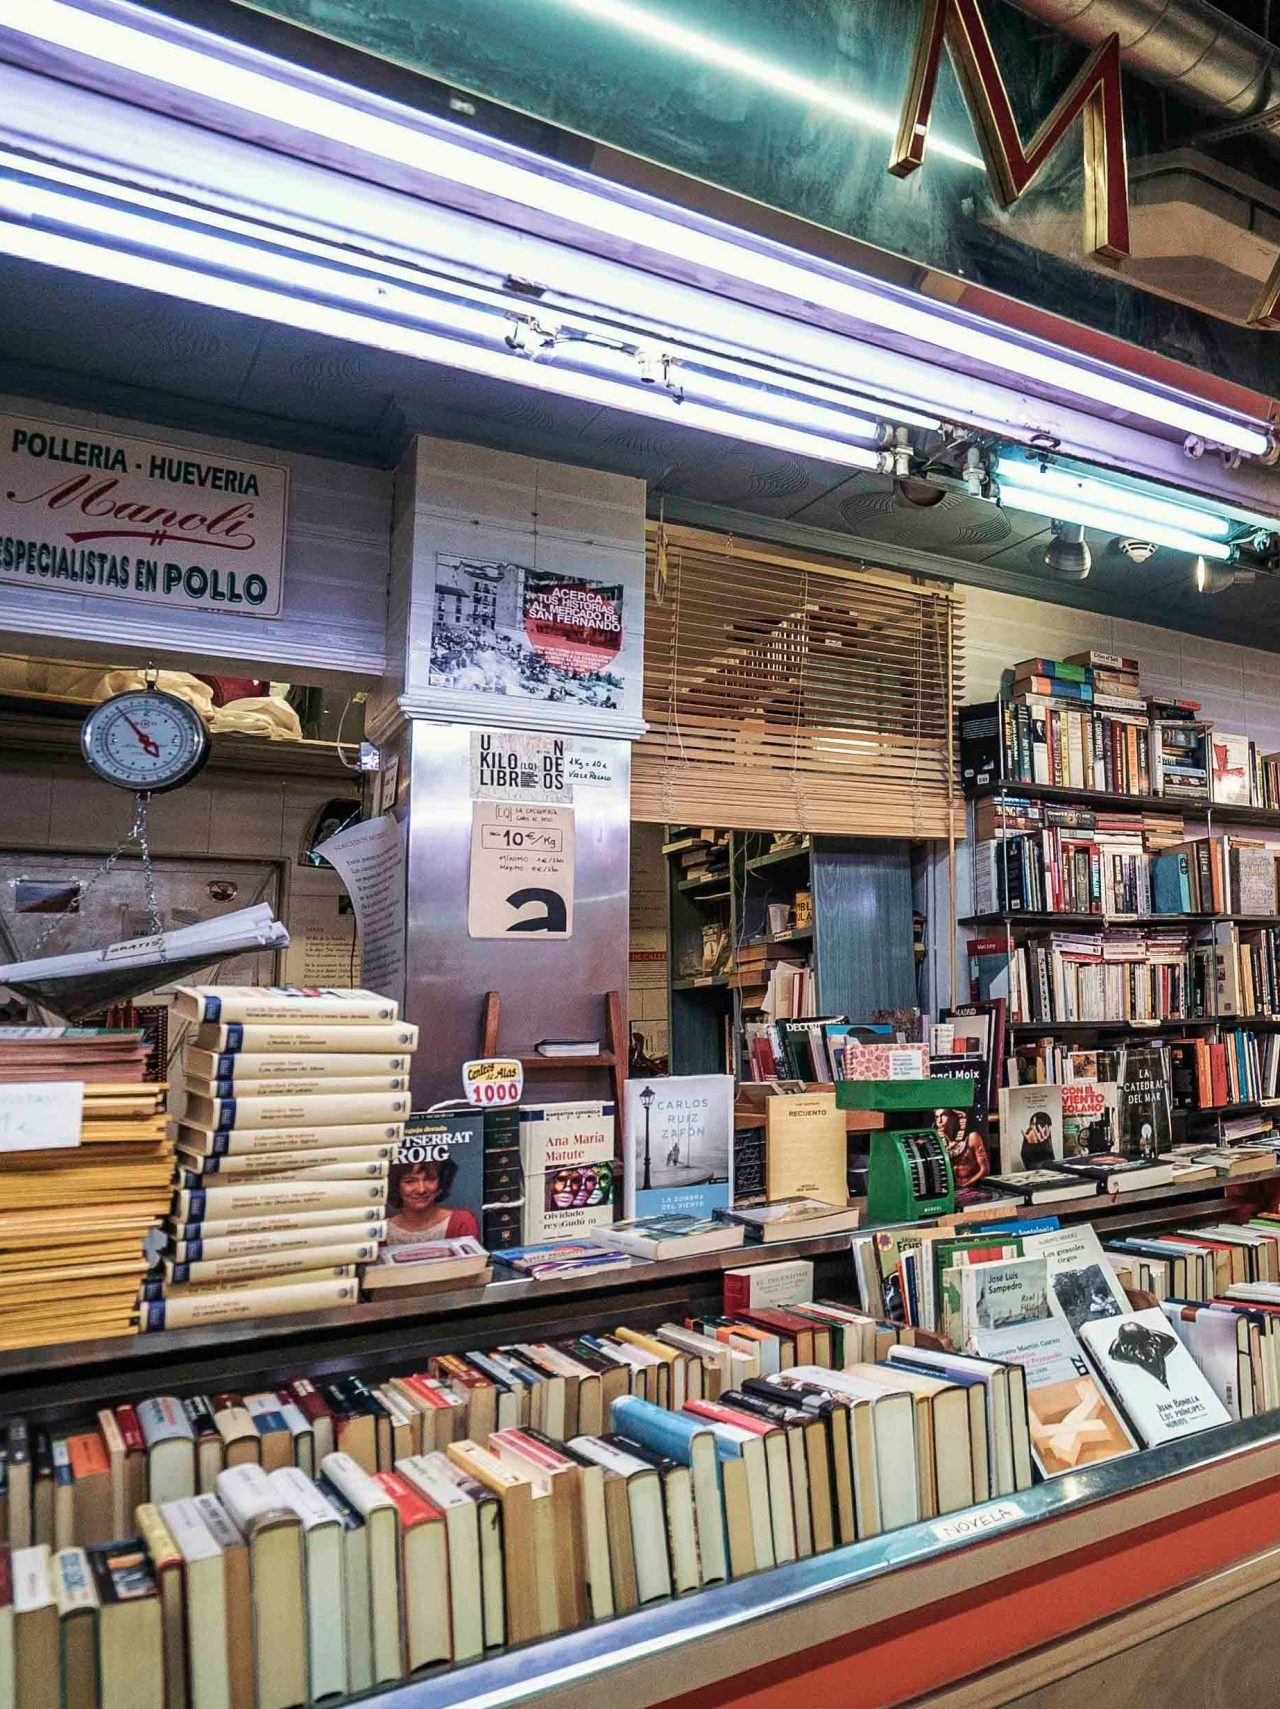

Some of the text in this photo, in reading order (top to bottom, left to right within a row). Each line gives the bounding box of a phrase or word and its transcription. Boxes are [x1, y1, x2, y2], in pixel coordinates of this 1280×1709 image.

[12, 428, 260, 497] POLLERIA HUEVERIA
[6, 473, 256, 537] Manoli
[135, 559, 157, 592] EN
[162, 562, 268, 606] POLLO
[552, 587, 603, 605] ACERCA
[538, 593, 615, 616] TUS HISTORIAS
[531, 601, 620, 624] AL MERCADO DE
[528, 609, 621, 632] SAN FERNANDO
[480, 752, 564, 773] KILO DE
[995, 805, 1016, 816] KNG
[955, 1069, 980, 1080] Moix
[1138, 1068, 1150, 1079] LA
[1061, 1085, 1095, 1096] CON EL
[1123, 1079, 1165, 1092] CATEDRAL
[472, 1083, 519, 1103] 1000
[1061, 1093, 1105, 1104] VIENTO
[1128, 1092, 1161, 1104] DEL MAR
[657, 1098, 709, 1111] CARLOS
[1061, 1104, 1103, 1114] SOLANO
[788, 1108, 828, 1118] RECUENTO
[545, 1137, 569, 1148] Ana
[392, 1145, 451, 1166] ROIG
[544, 1149, 585, 1163] Matute
[661, 1193, 704, 1205] LA SOMBRA
[661, 1200, 705, 1211] DEL VIENTO
[543, 1209, 585, 1222] Olvidado
[543, 1222, 558, 1231] rey
[1042, 1244, 1086, 1259] Los girasoles
[988, 1271, 1019, 1285] José Luis
[988, 1282, 1023, 1296] Sampedro
[942, 1508, 1012, 1537] NOVELA
